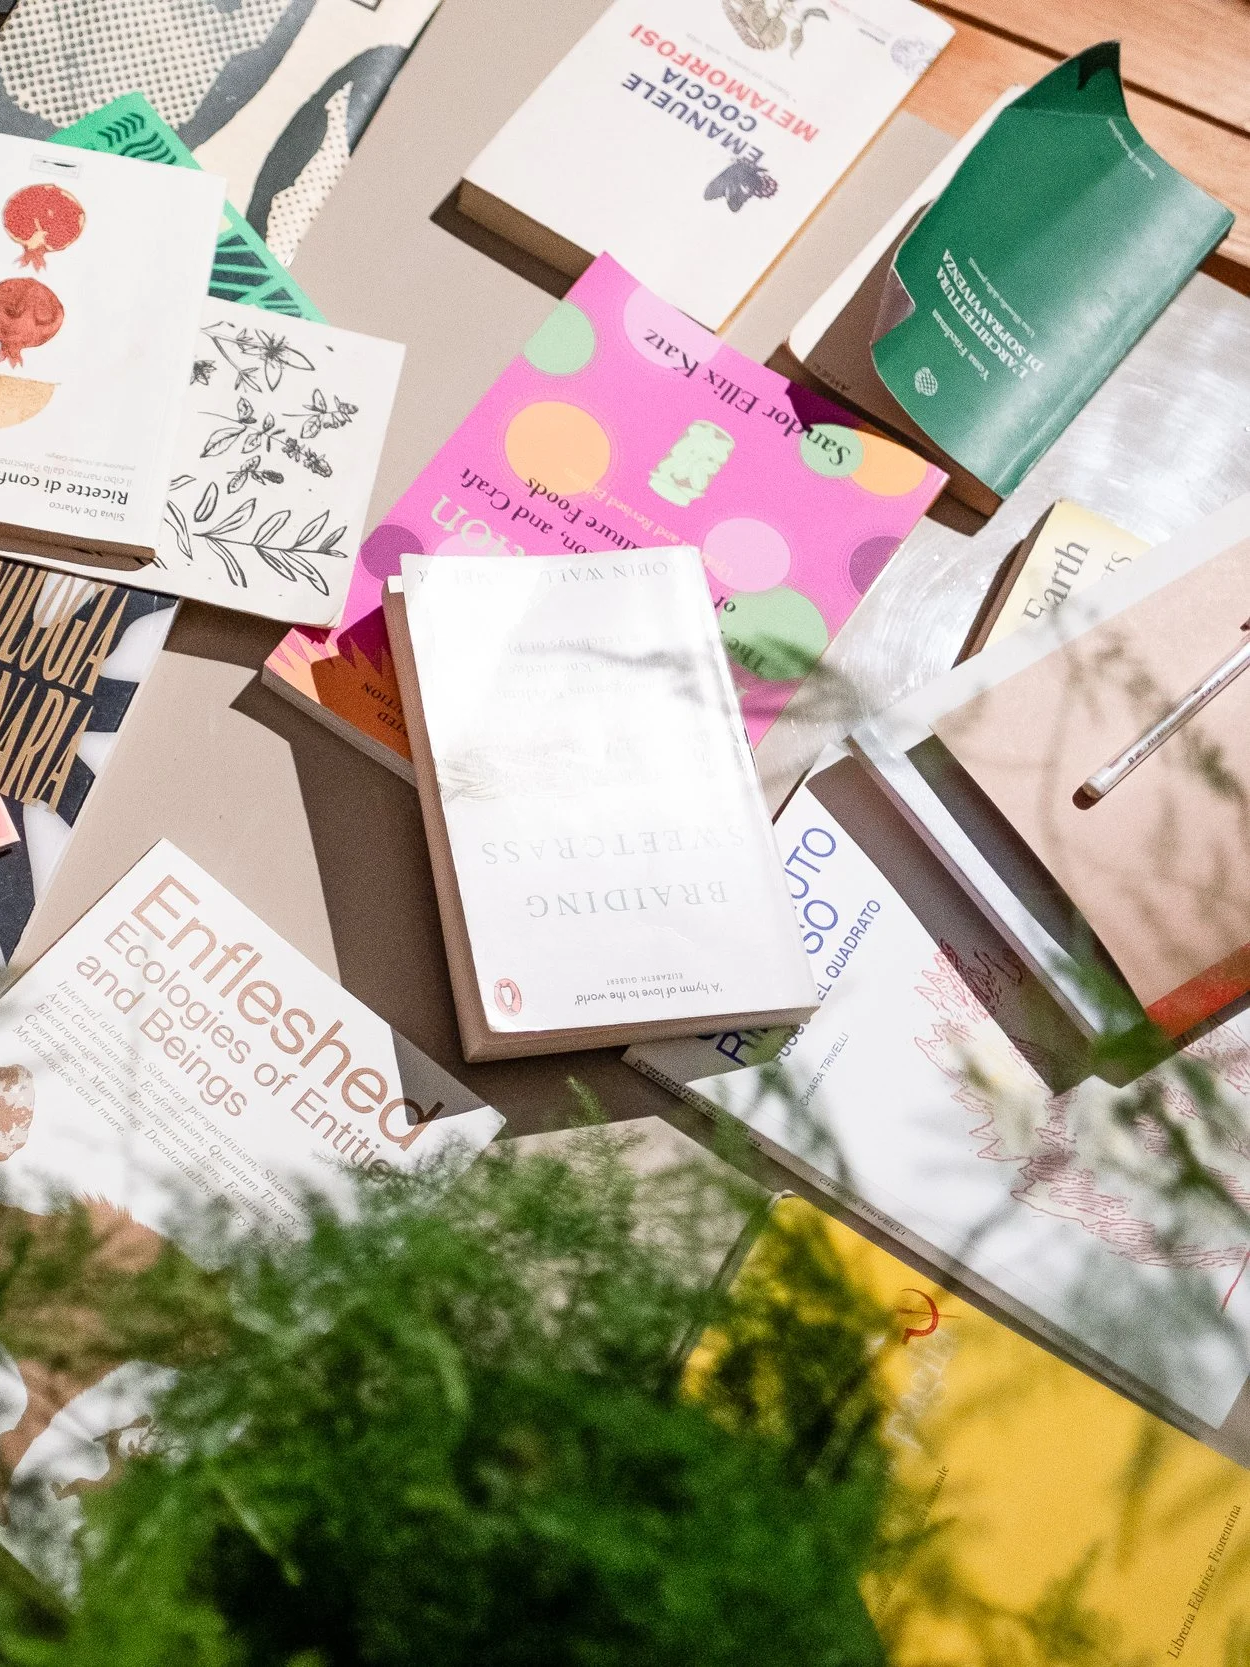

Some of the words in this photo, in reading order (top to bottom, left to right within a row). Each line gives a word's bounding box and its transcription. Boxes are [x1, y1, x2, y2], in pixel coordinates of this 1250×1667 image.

[628, 22, 819, 143] METAMORFOSI
[663, 65, 758, 133] COCCIA
[620, 71, 765, 164] EMANUELE
[940, 265, 1029, 380] L'ARCHITETTURA
[944, 248, 1026, 357] SOPRAVVIVENZA
[636, 326, 702, 379] Katz
[1022, 350, 1045, 374] DI
[694, 365, 759, 417] Ellix
[756, 398, 852, 471] Sandor
[43, 478, 62, 495] di
[47, 500, 81, 515] Marco
[65, 481, 128, 505] Ricette
[83, 507, 97, 517] De
[458, 466, 510, 510] Craft
[524, 476, 582, 523] Foods
[99, 509, 125, 522] Silvia
[509, 502, 553, 534] and
[1021, 546, 1089, 618] Earth
[526, 880, 728, 917] BRAIDING
[825, 896, 885, 980] QUADRATO
[604, 975, 636, 986] GILBERT
[609, 990, 625, 1003] the
[627, 989, 638, 1000] to
[640, 971, 682, 983] ELIZABETH
[641, 986, 663, 1000] love
[665, 986, 676, 997] of
[678, 980, 708, 997] hymn
[71, 945, 147, 1018] and
[130, 1005, 258, 1126] Beings
[94, 916, 262, 1073] Ecologies
[248, 1050, 300, 1102] of
[128, 870, 445, 1152] Enfleshed
[34, 1000, 129, 1093] Electromagnetism;
[126, 1088, 226, 1184] Environmentalism;
[45, 989, 139, 1082] Anti-Cartesianism;
[137, 1077, 211, 1148] Ecofeminism;
[205, 1142, 261, 1195] Quantum
[56, 977, 100, 1021] Internal
[96, 1017, 146, 1065] alchemy;
[142, 1059, 190, 1106] Siberian
[184, 1101, 263, 1176] perspectivism;
[797, 1070, 827, 1106] CHIARA
[818, 1031, 850, 1072] TRIVELLI
[23, 1011, 92, 1079] Cosmologies;
[86, 1073, 147, 1132] Mumming;
[143, 1126, 216, 1198] Decoloniality;
[73, 1081, 100, 1108] and
[95, 1105, 128, 1136] more.
[1165, 1611, 1195, 1658] Libreria
[1186, 1563, 1216, 1610] Editrice
[1206, 1503, 1241, 1563] Fiorentina
